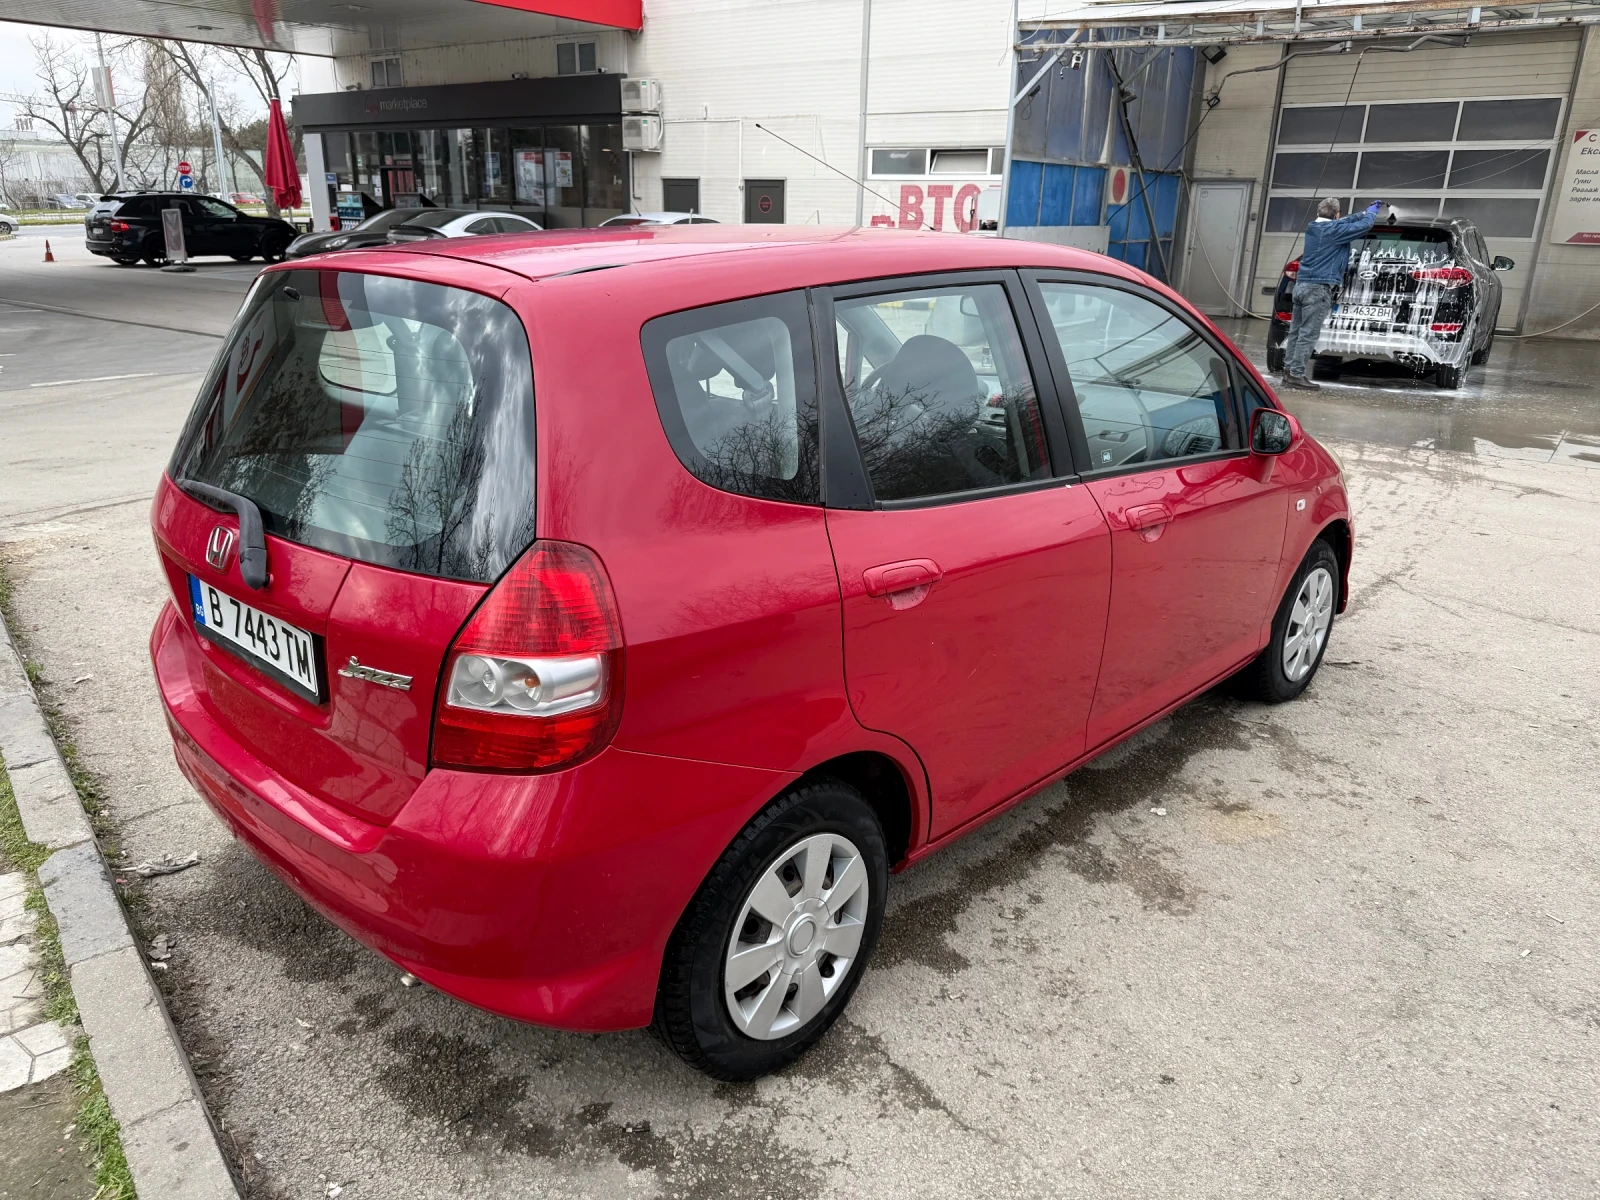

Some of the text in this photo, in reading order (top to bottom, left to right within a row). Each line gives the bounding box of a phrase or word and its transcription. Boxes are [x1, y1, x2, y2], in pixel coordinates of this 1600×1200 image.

[380, 97, 428, 112] marketplace
[1580, 147, 1600, 155] Екс
[1573, 177, 1592, 185] Гуми
[1342, 305, 1349, 314] B
[1377, 308, 1391, 318] BH
[195, 603, 205, 617] BG
[208, 586, 313, 684] B 7443 TM
